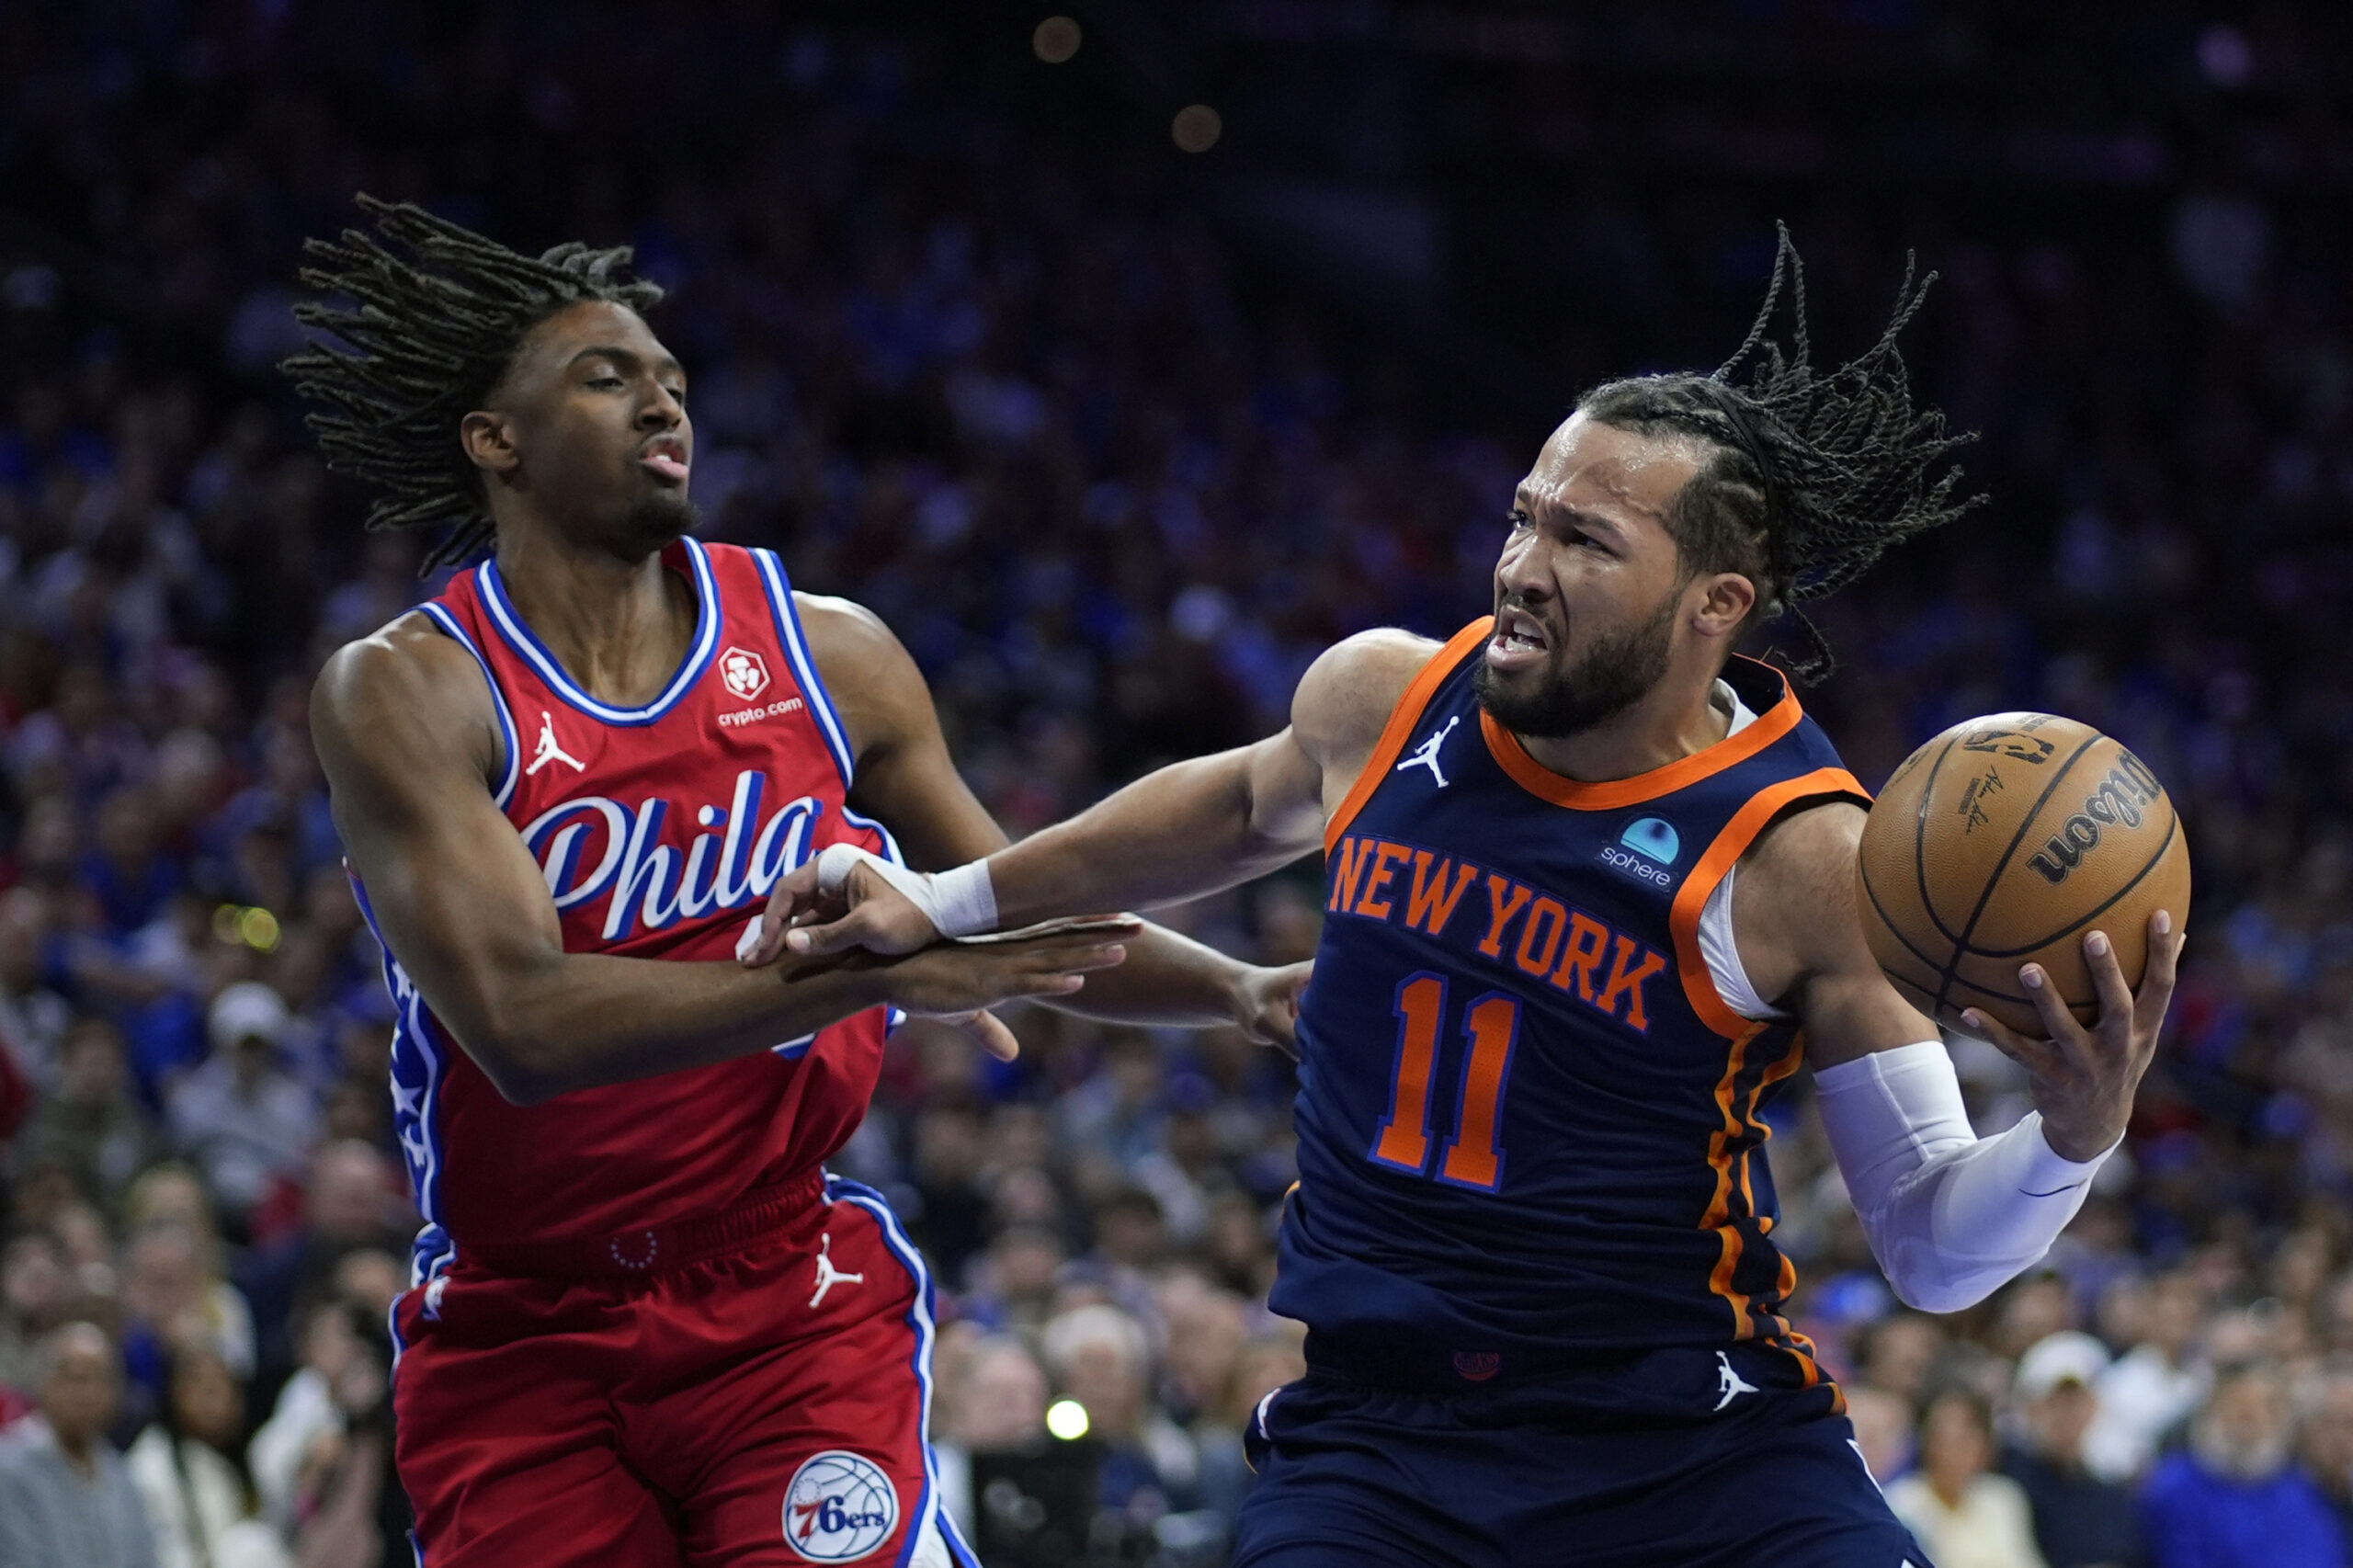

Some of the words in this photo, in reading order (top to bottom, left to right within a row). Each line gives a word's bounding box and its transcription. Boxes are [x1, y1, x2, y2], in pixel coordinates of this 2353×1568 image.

[718, 697, 803, 727] crypto.com
[520, 769, 823, 940] Phila
[1601, 845, 1670, 887] sphere
[1329, 836, 1477, 936] NEW
[1475, 873, 1666, 1032] YORK
[1368, 970, 1521, 1194] 11
[794, 1495, 885, 1539] 76ers
